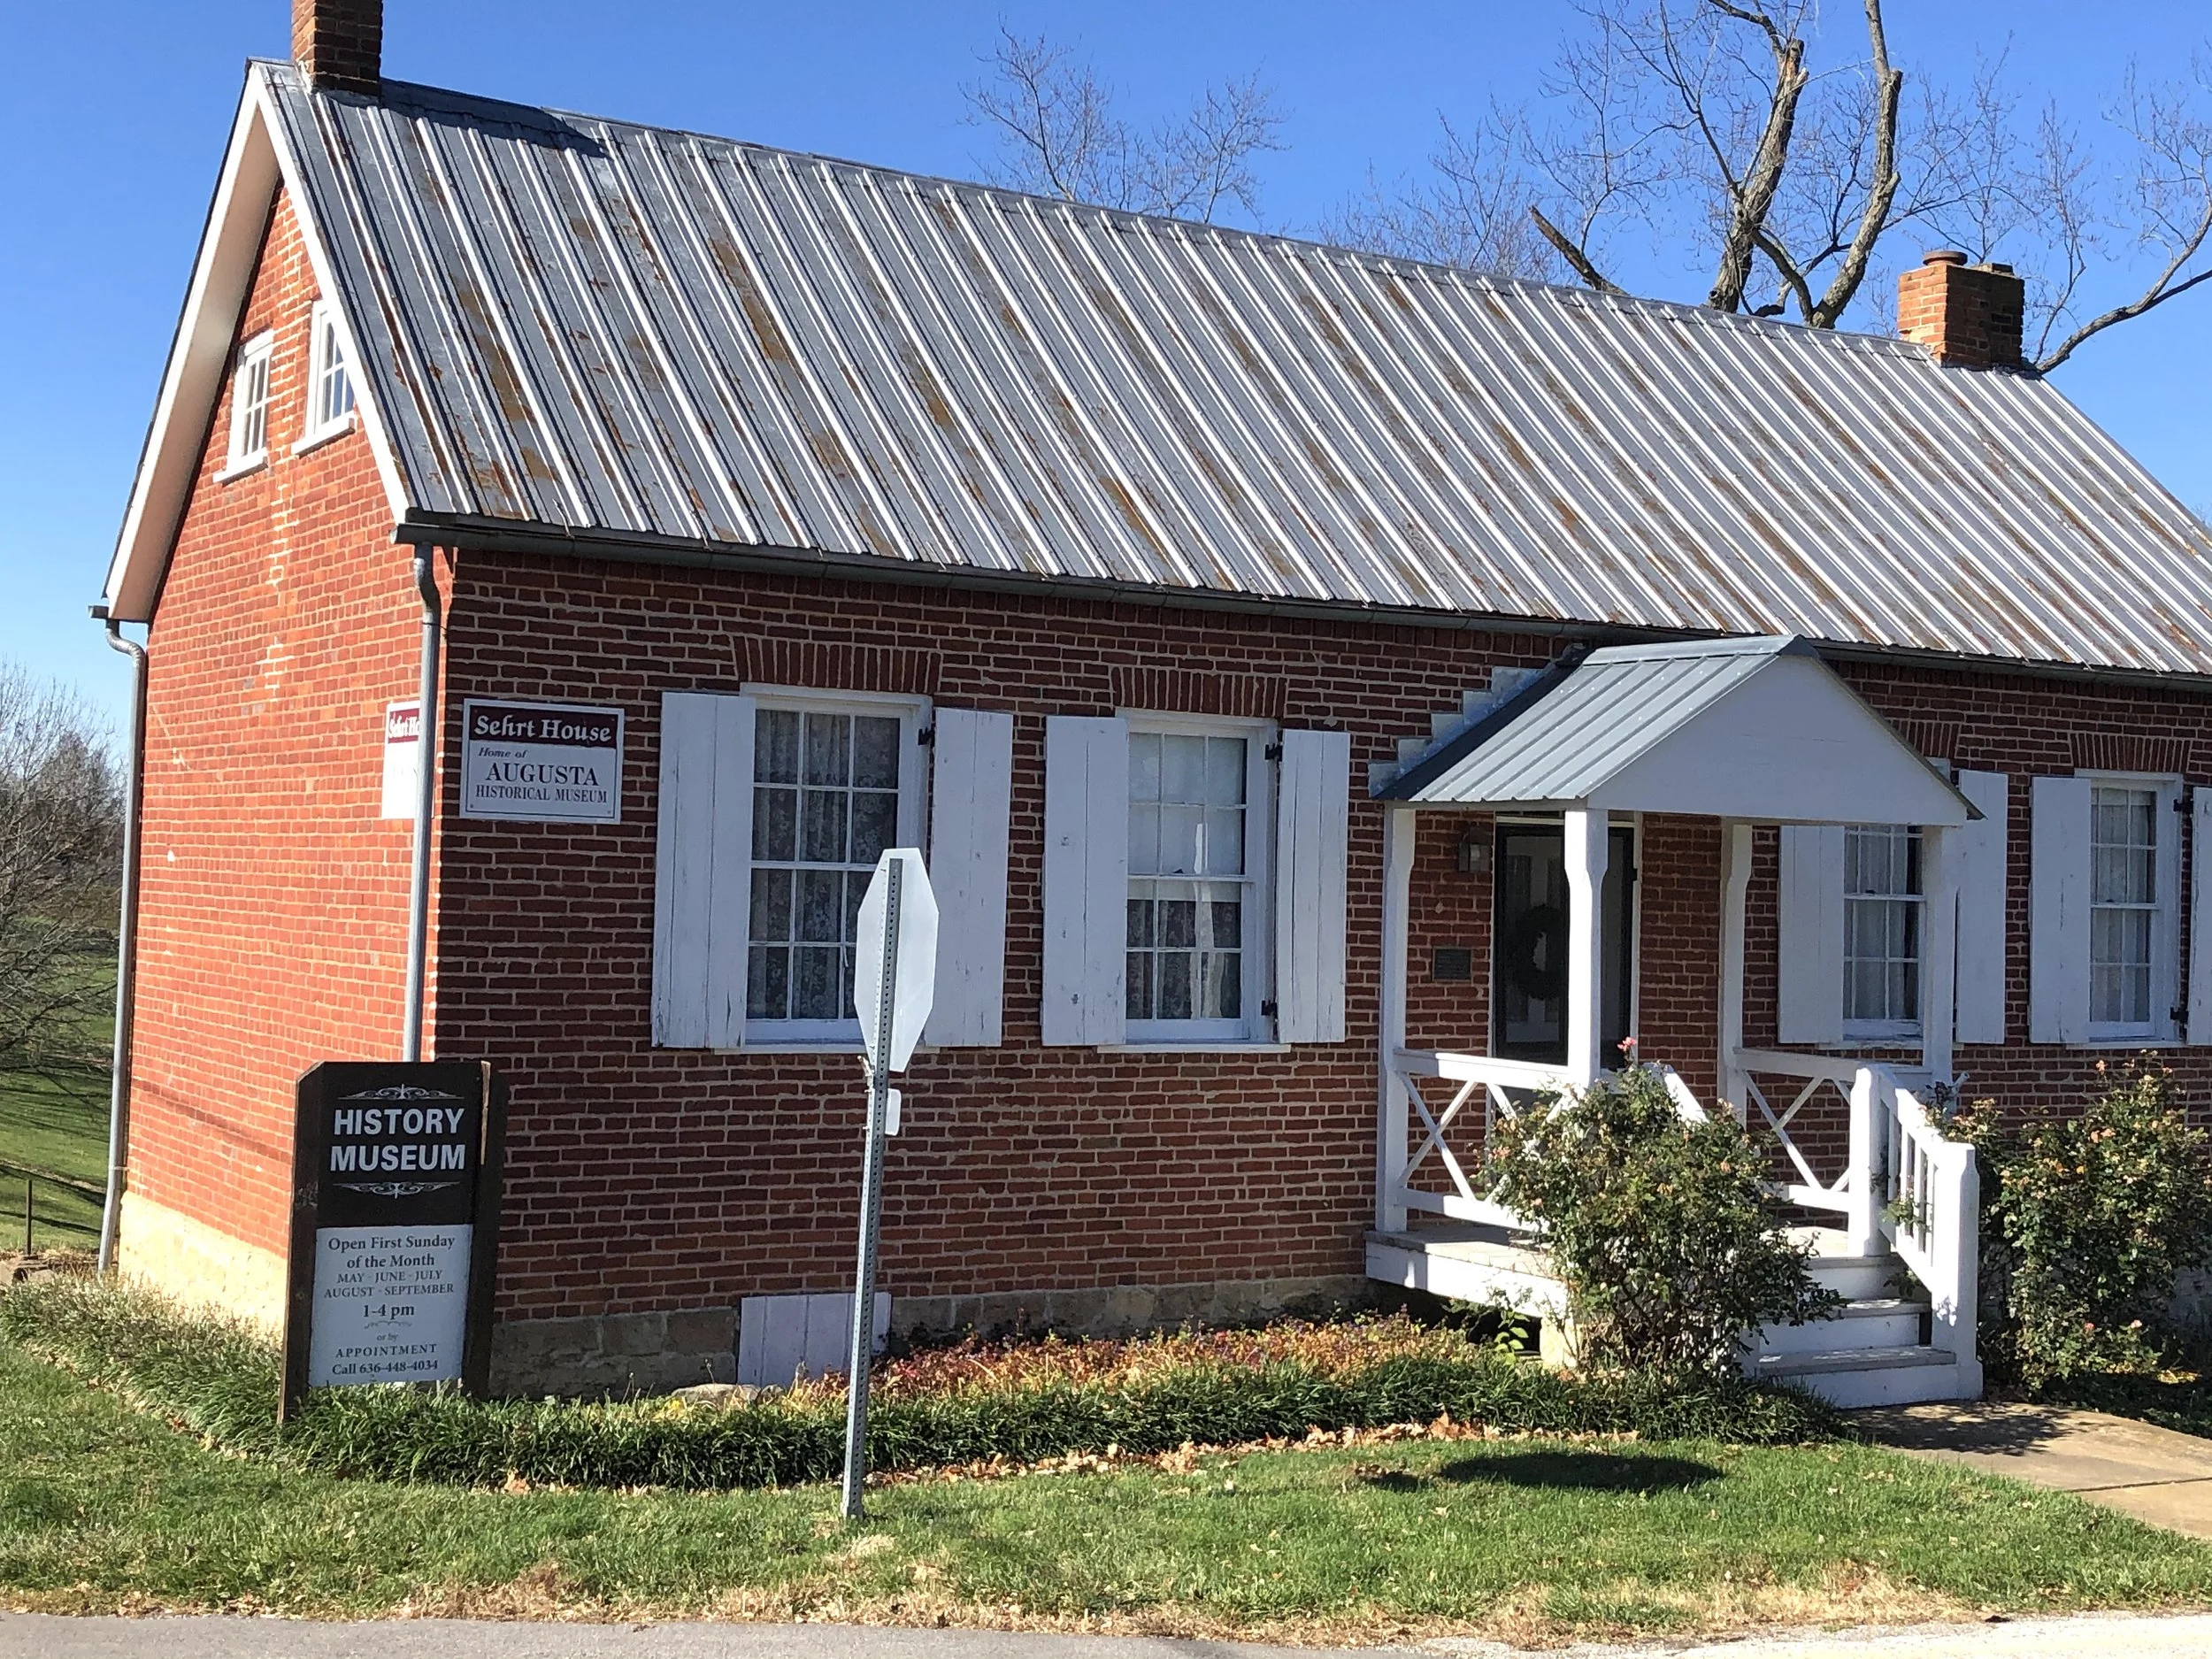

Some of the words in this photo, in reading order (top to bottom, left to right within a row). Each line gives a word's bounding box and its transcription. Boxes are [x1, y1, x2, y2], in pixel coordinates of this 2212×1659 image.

[474, 715, 535, 737] Sehrt
[539, 719, 611, 741] House
[479, 747, 511, 758] Home
[515, 749, 527, 758] of
[486, 763, 599, 786] AUGUSTA
[476, 785, 550, 801] HISTORICAL
[555, 788, 607, 803] MUSEUM
[334, 1108, 465, 1135] HISTORY
[330, 1144, 465, 1171] MUSEUM
[328, 1237, 366, 1253] Open
[371, 1236, 402, 1249] First
[405, 1234, 455, 1250] Sunday
[347, 1256, 362, 1269] of
[365, 1255, 387, 1268] the
[389, 1253, 434, 1266] Month
[337, 1272, 365, 1284] MAY
[374, 1271, 406, 1283] JUNE
[415, 1270, 442, 1281] JULY
[324, 1286, 374, 1298] AUGUST
[384, 1283, 454, 1295] SEPTEMBER
[364, 1304, 387, 1317] 1-4
[390, 1305, 415, 1319] pm
[388, 1333, 398, 1342] by
[335, 1344, 437, 1358] APPOINTMENT
[332, 1363, 356, 1376] Call
[359, 1359, 438, 1373] 636-448-4034
